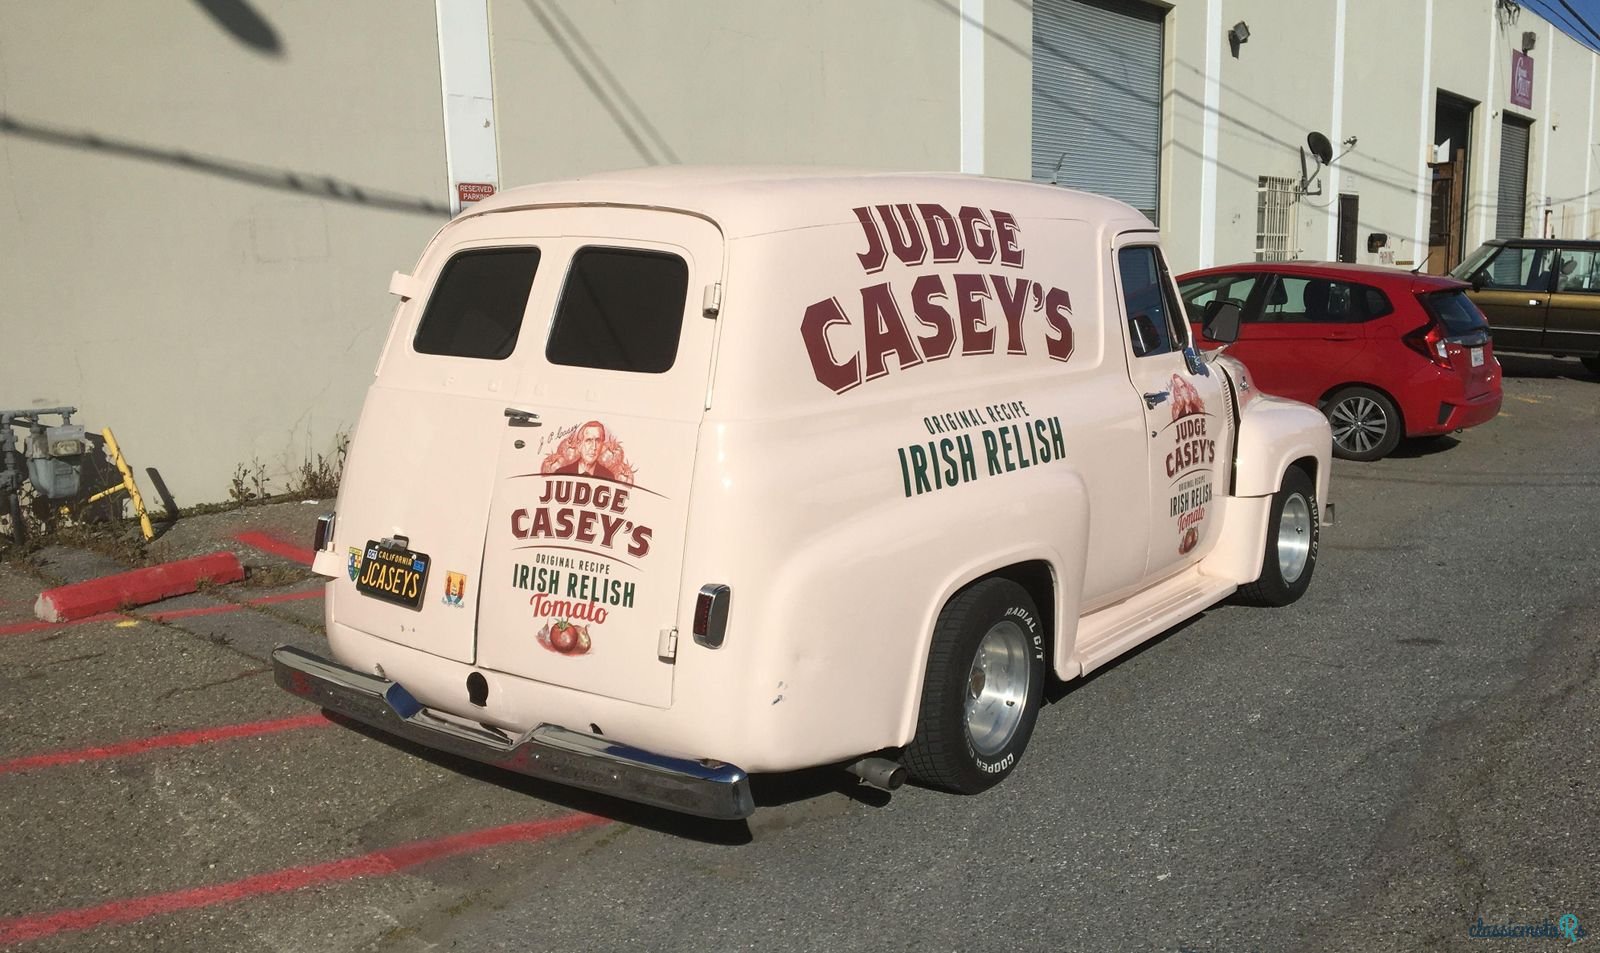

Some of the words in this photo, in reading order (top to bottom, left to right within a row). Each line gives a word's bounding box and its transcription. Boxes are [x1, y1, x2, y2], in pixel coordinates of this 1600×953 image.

[852, 203, 1025, 275] JUDGE
[800, 273, 1075, 395] CASEY'S
[923, 408, 987, 435] ORIGINAL
[986, 400, 1030, 425] RECIPE
[1175, 417, 1207, 444] JUDGE
[897, 434, 978, 498] IRISH
[982, 416, 1067, 476] RELISH
[1165, 439, 1216, 479] CASEY'S
[539, 480, 630, 514] JUDGE
[1170, 488, 1189, 518] IRISH
[1191, 482, 1212, 509] RELISH
[511, 507, 653, 558] CASEY'S
[1177, 506, 1206, 534] Tomato
[1309, 496, 1319, 537] RADIAL
[378, 550, 413, 566] CALIFORNIA
[535, 553, 575, 570] ORIGINAL
[578, 560, 611, 575] RECIPE
[361, 560, 420, 598] JCASEYS
[512, 563, 561, 595] IRISH
[567, 572, 636, 608] RELISH
[529, 593, 609, 624] Tomato
[1005, 607, 1034, 632] RADIAL
[1033, 635, 1044, 661] G/T
[976, 753, 1014, 773] COOPER
